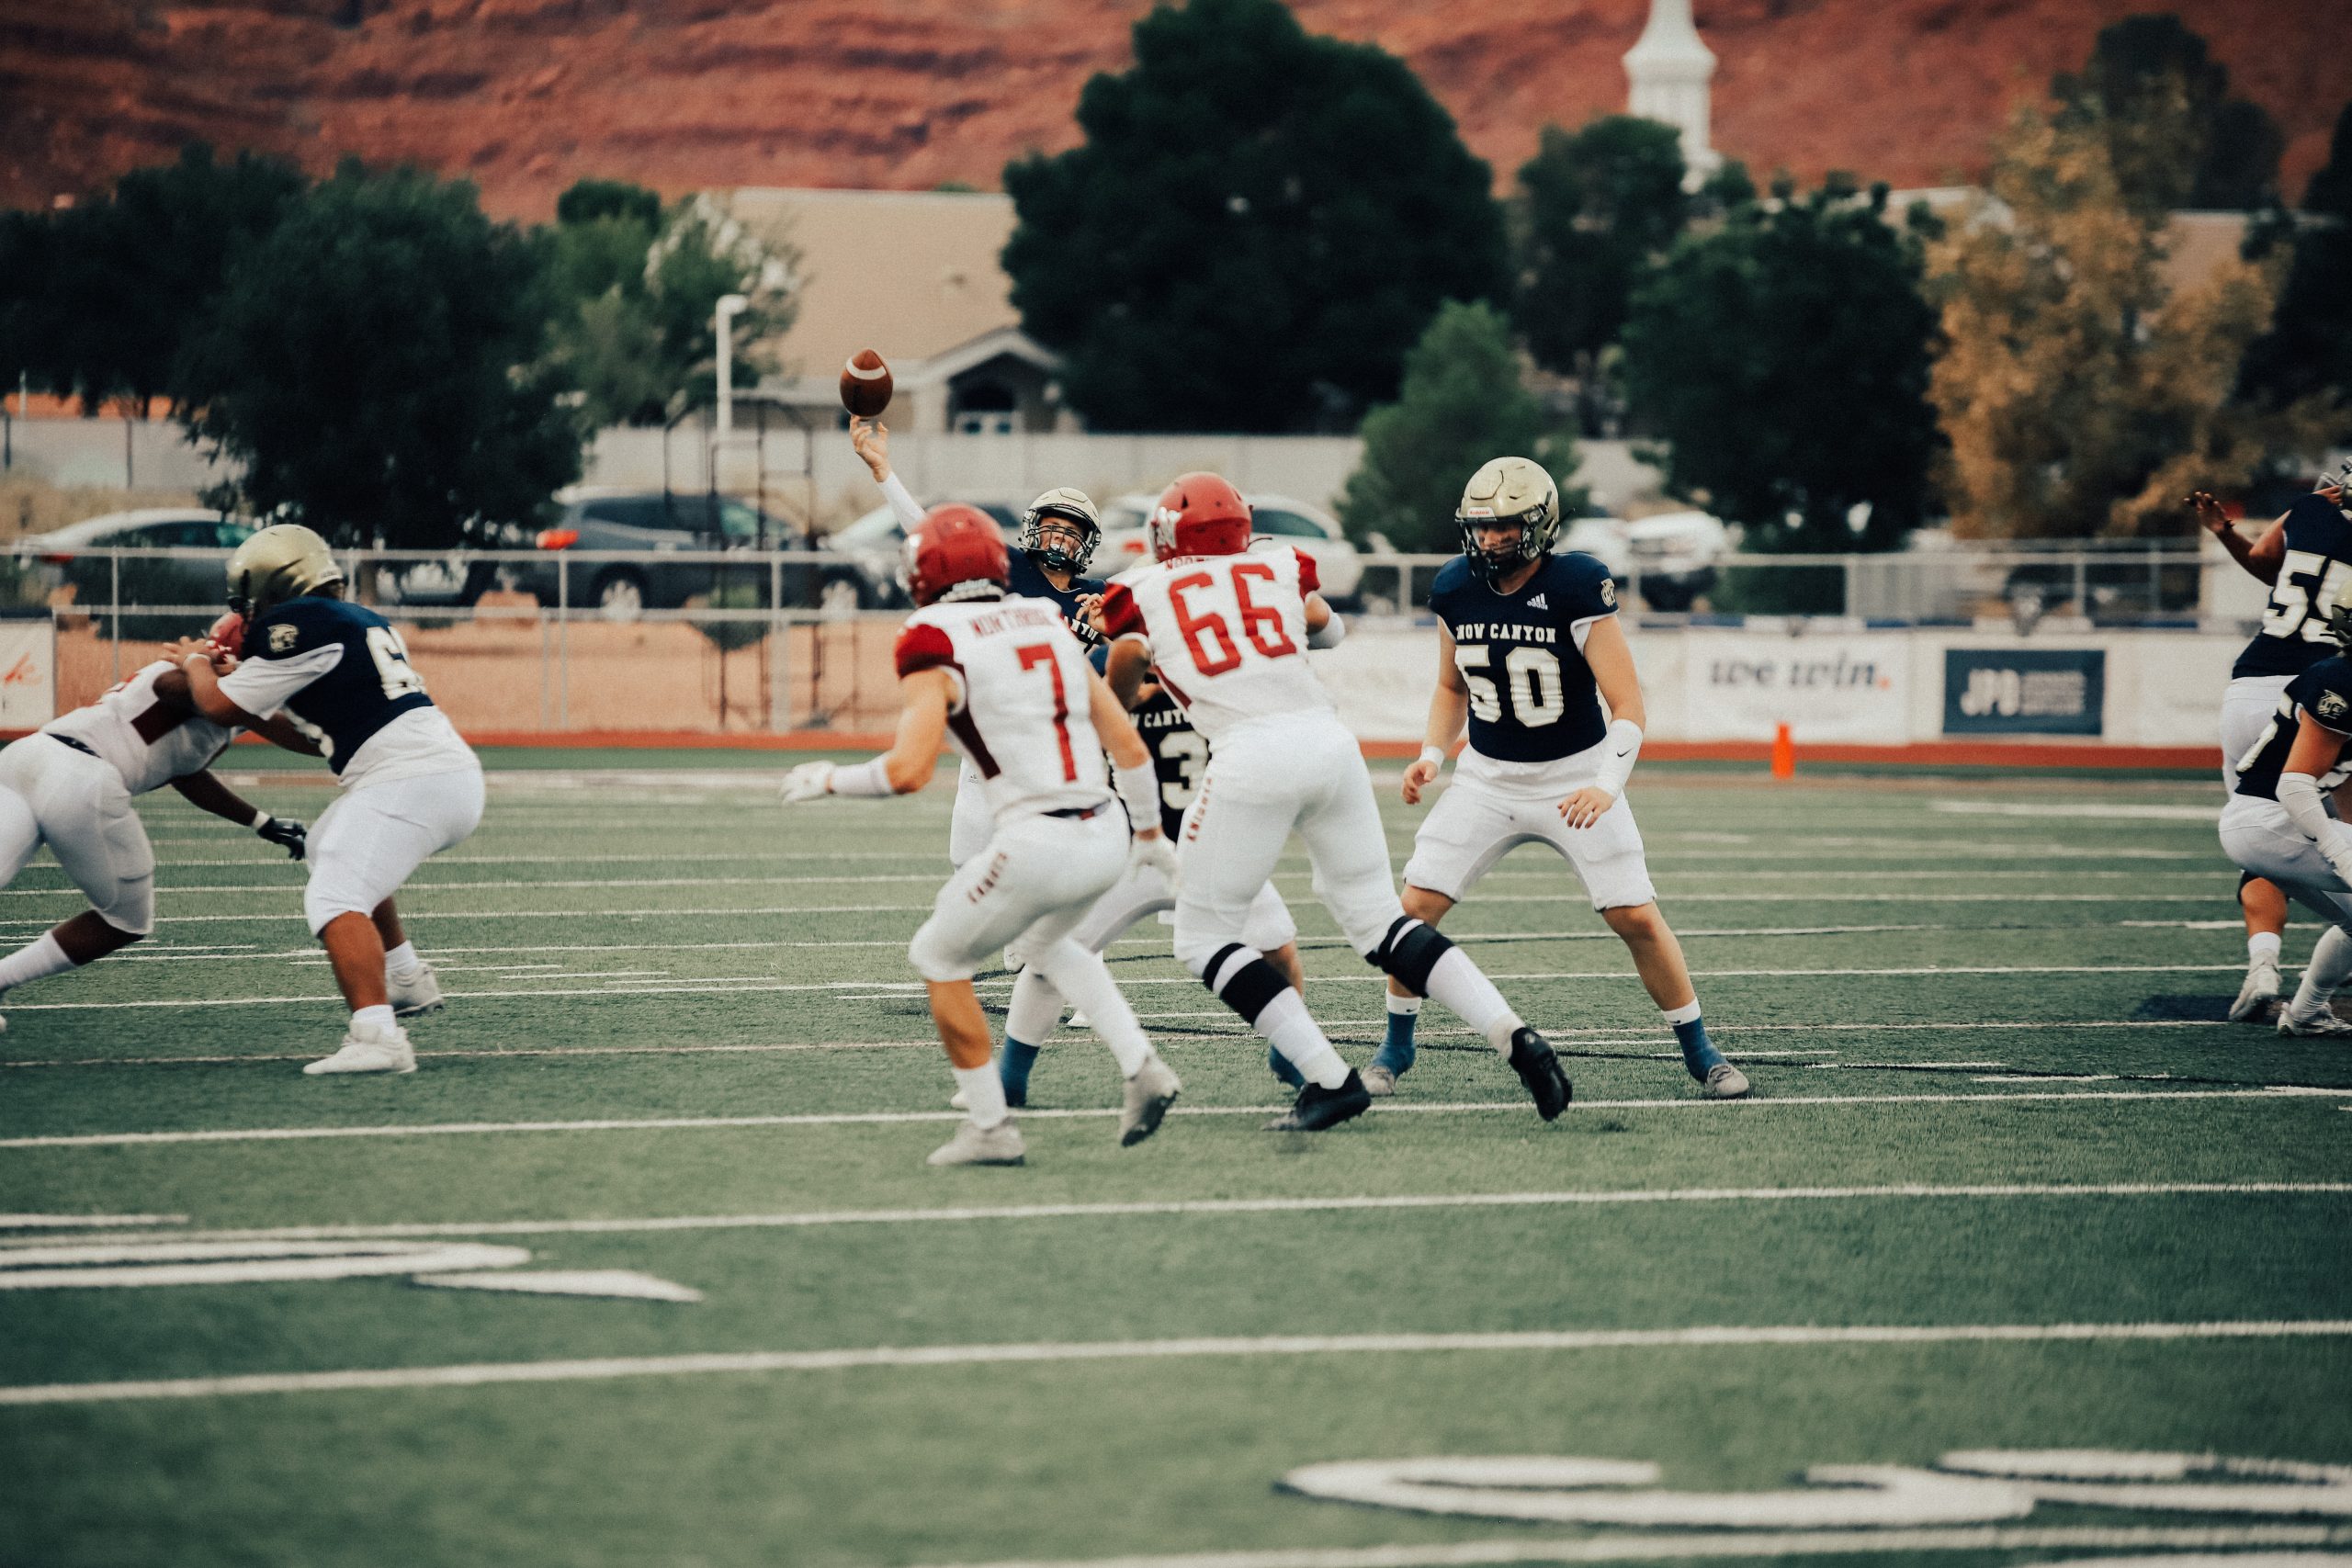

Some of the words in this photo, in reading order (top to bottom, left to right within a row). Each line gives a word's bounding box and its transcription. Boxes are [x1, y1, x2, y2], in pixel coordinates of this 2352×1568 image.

[1169, 562, 1297, 678] 66
[1456, 624, 1485, 640] NOW
[1489, 623, 1556, 643] CANYON
[1016, 643, 1077, 783] 7
[1454, 645, 1564, 728] 50
[1711, 658, 1777, 686] we
